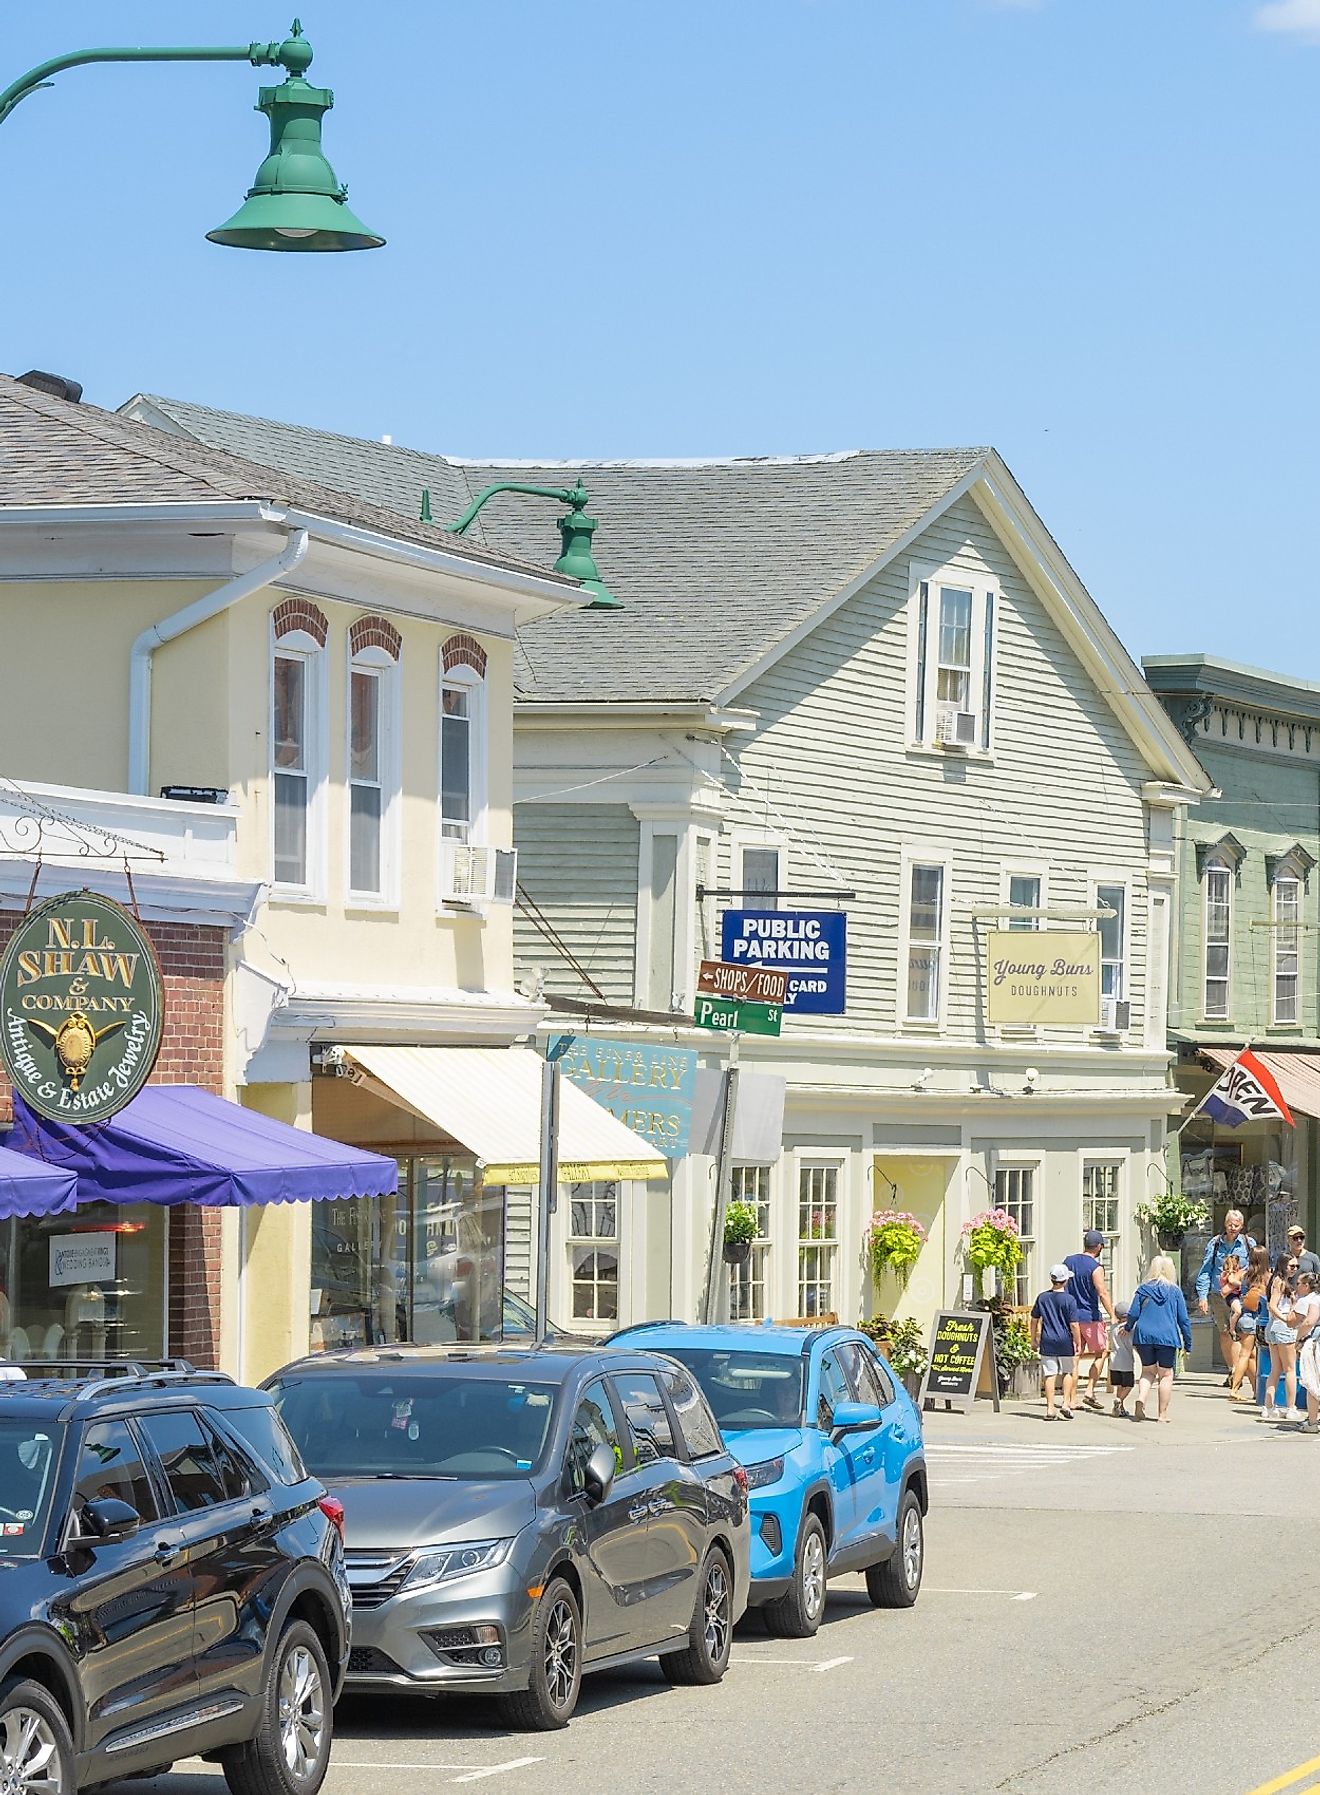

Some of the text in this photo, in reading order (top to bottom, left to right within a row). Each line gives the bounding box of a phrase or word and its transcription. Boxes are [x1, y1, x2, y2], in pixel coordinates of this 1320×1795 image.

[45, 917, 116, 951] N.L.
[742, 918, 821, 939] PUBLIC
[732, 939, 830, 961] PARKING
[16, 949, 141, 990] SHAW
[993, 958, 1094, 986] Young Buns
[69, 977, 90, 996] &
[713, 967, 786, 999] SHOPS/FOOD
[789, 979, 828, 994] CARD
[1011, 984, 1079, 997] DOUGHNUTS
[21, 994, 136, 1013] COMPANY
[700, 1001, 779, 1028] Pearl St
[6, 1007, 152, 1112] Antique & Estate Jewelry
[557, 1054, 688, 1091] GALLERY
[1216, 1066, 1278, 1116] OPEN
[945, 1320, 975, 1332] Fresh
[936, 1331, 979, 1343] DOUGHNUTS
[949, 1344, 960, 1354] &
[933, 1354, 976, 1366] HOT COFFEE
